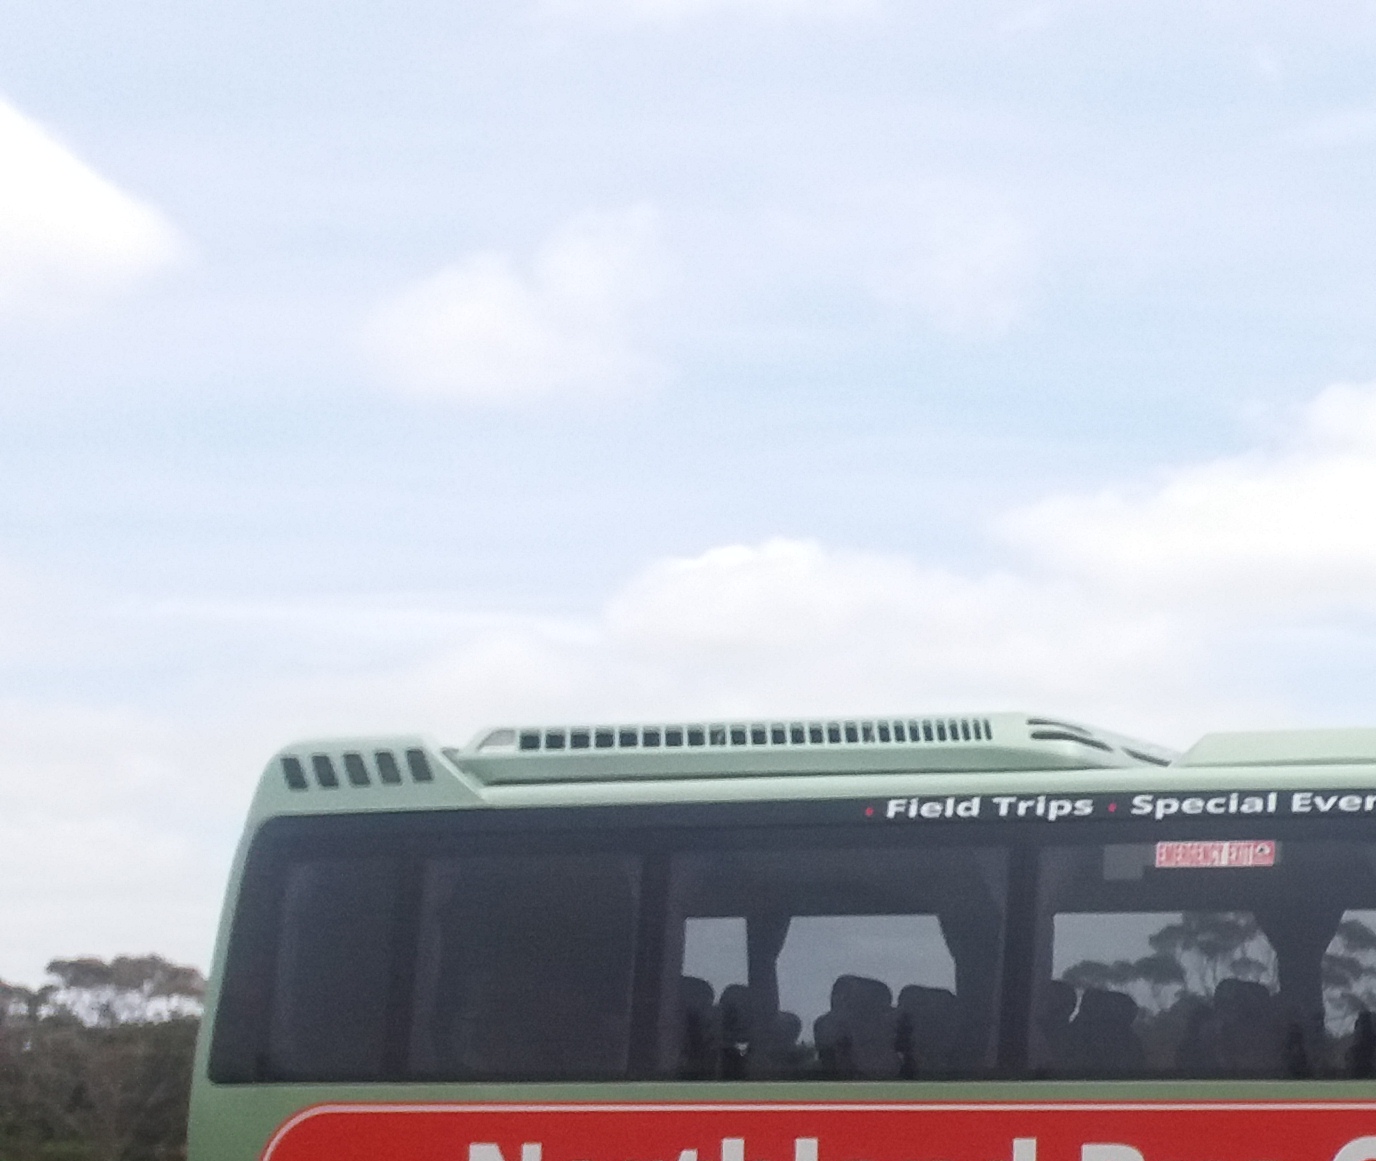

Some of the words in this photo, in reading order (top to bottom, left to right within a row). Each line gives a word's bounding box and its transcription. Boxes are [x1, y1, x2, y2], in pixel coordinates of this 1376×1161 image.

[885, 795, 981, 819] Field
[992, 795, 1094, 822] Trips
[1130, 791, 1278, 820] Special
